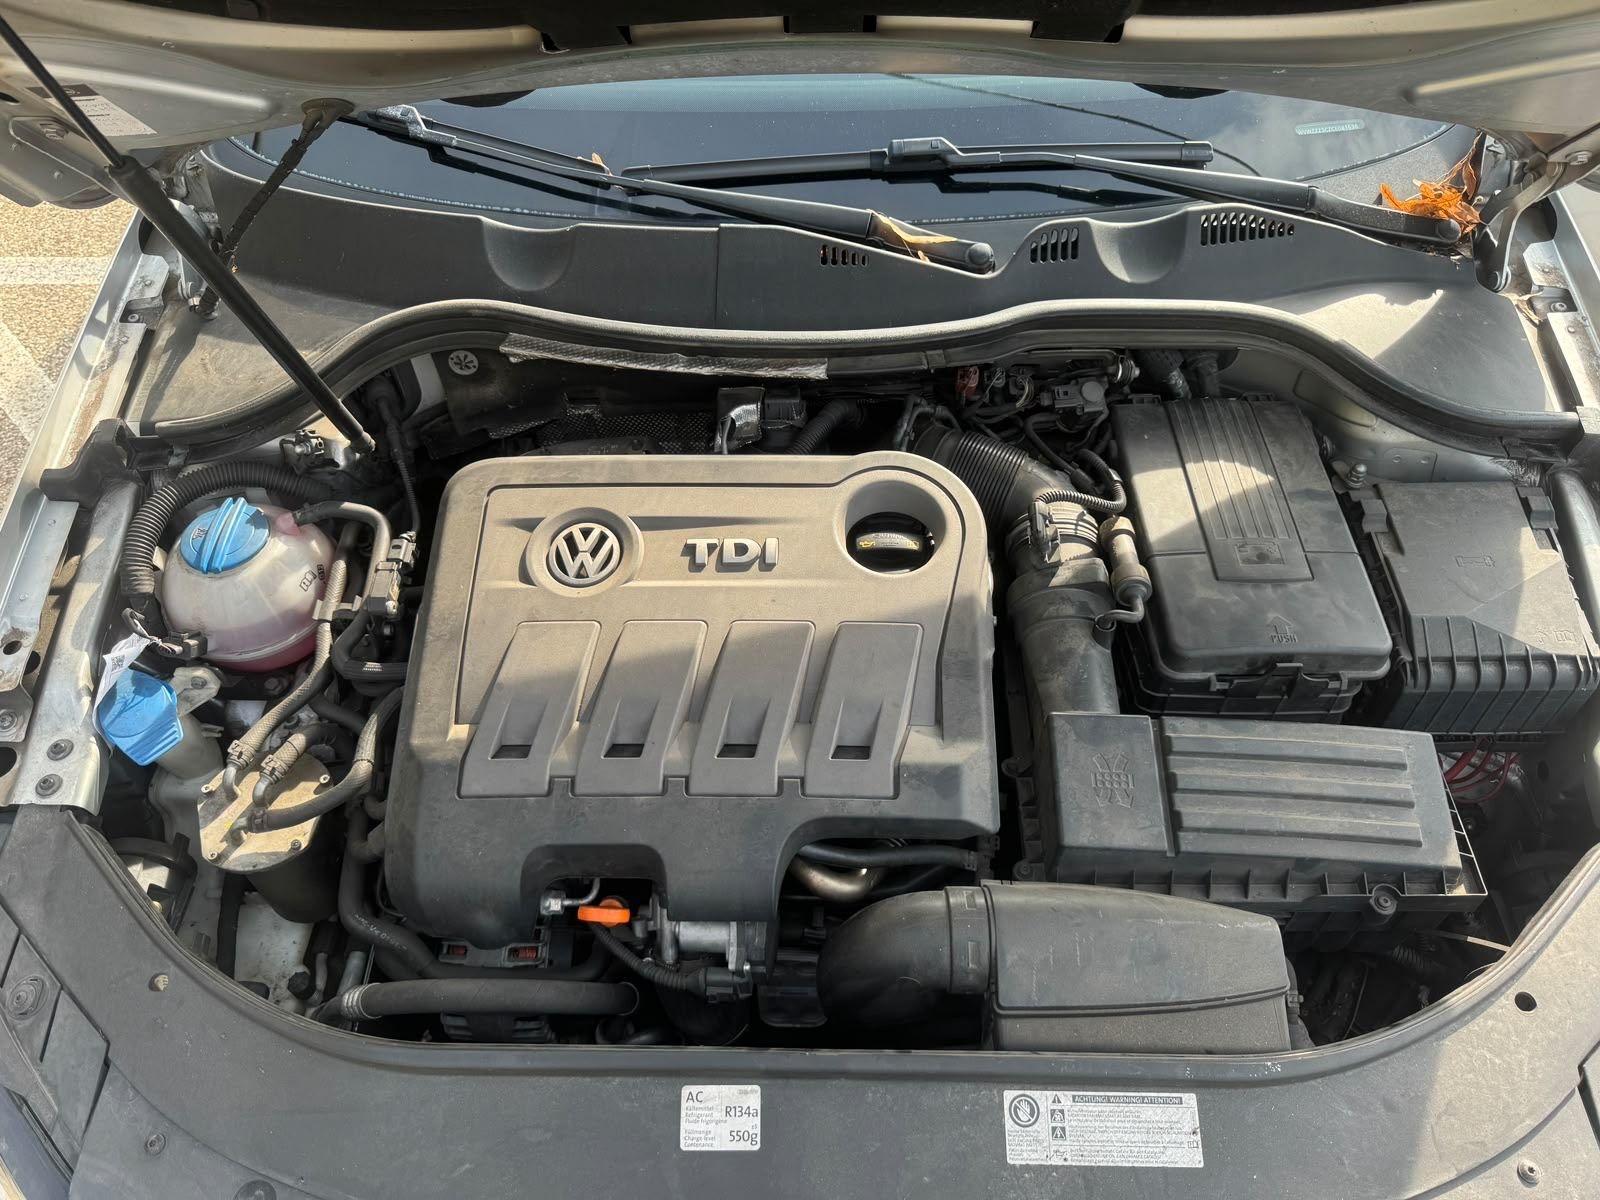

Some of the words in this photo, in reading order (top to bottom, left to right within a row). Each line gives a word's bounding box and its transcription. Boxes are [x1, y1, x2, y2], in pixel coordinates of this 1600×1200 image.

[685, 537, 780, 567] TDI
[1270, 633, 1298, 643] PUSH
[686, 1091, 704, 1103] AC
[1110, 1095, 1143, 1104] WARNING!
[1143, 1096, 1181, 1105] ATTENTION!
[725, 1105, 759, 1118] R134a
[729, 1130, 758, 1146] 550g
